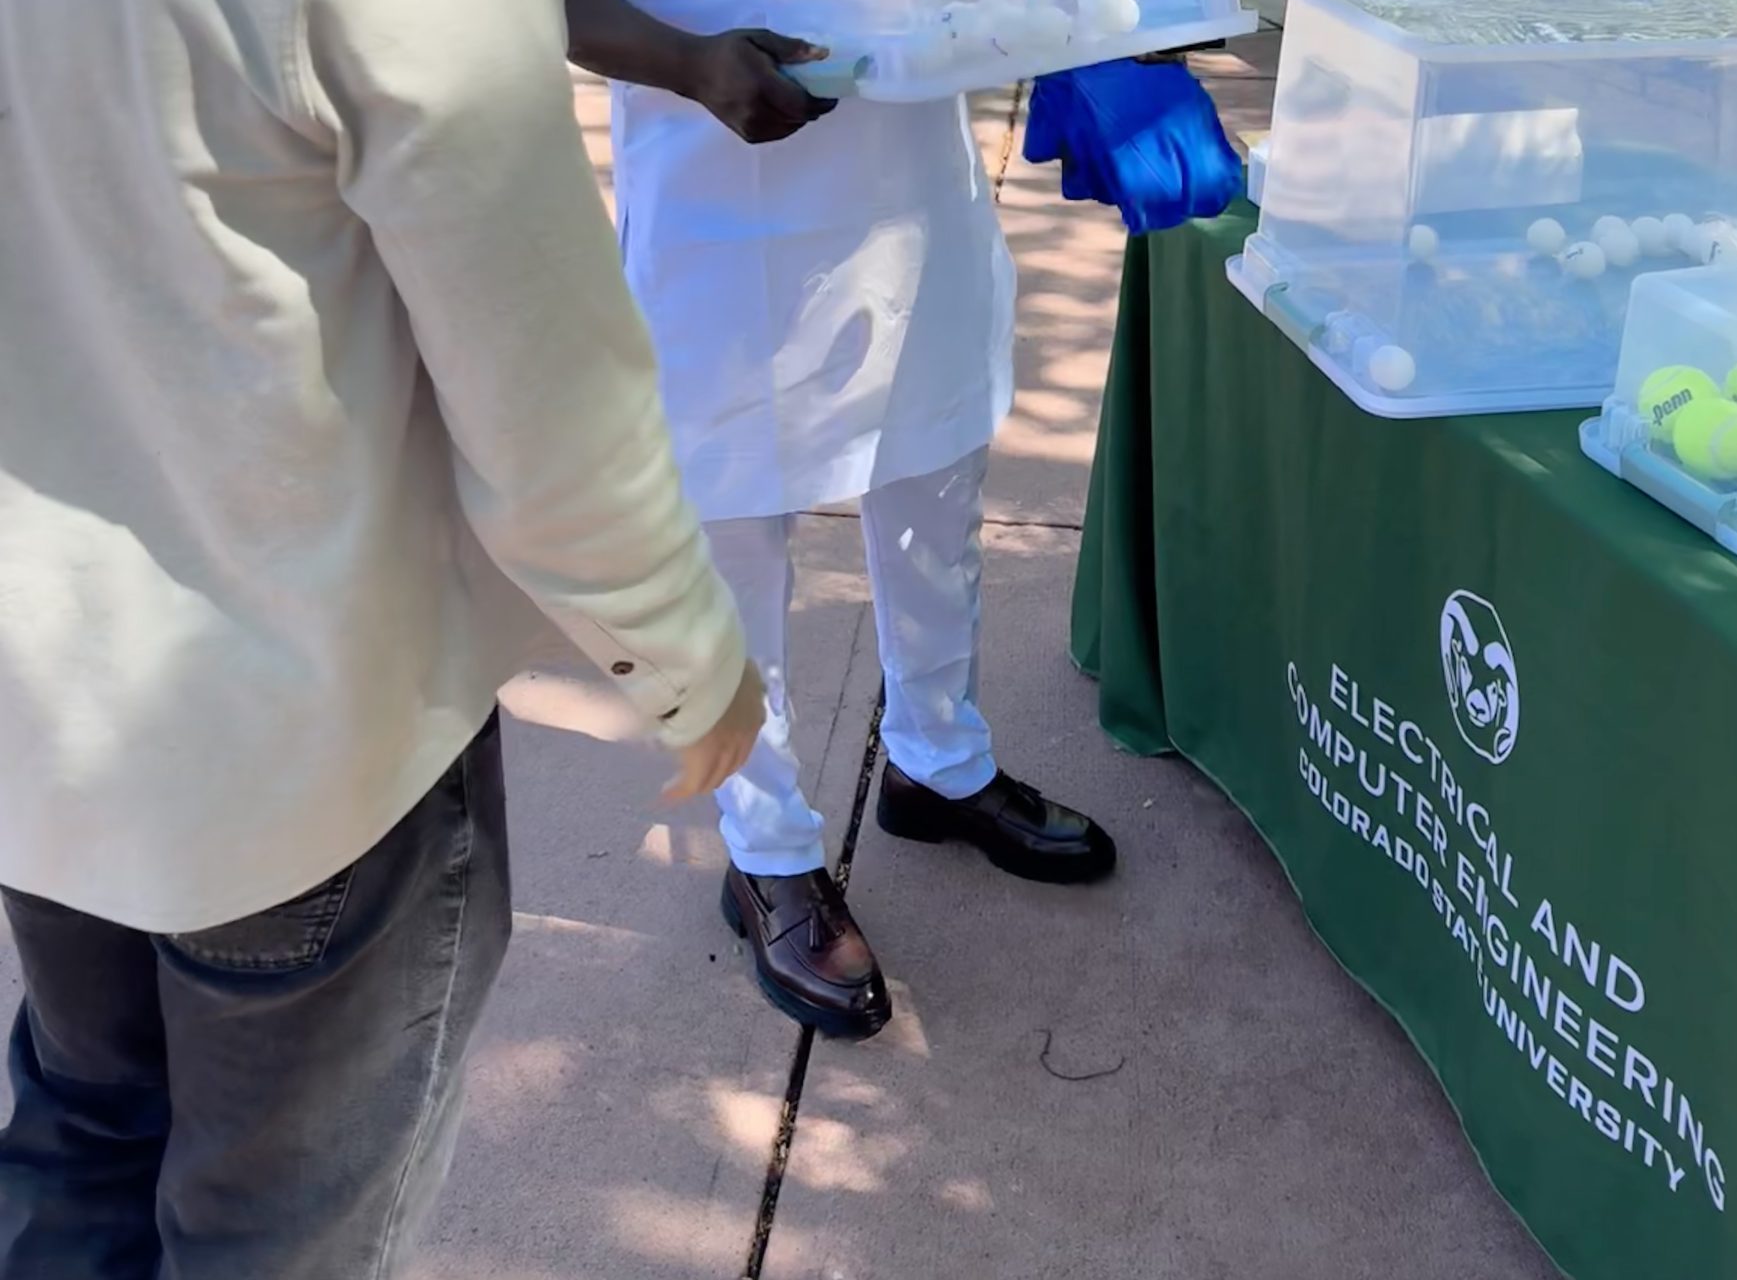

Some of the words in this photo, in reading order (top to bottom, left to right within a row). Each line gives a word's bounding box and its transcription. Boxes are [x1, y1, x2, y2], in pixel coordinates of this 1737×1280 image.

[1287, 661, 1447, 867] COMPUTER
[1457, 852, 1725, 1211] ENGINEERING
[1299, 748, 1429, 889] COLORADO
[1483, 975, 1685, 1192] UNIVERSITY
[1330, 663, 1519, 908] ELECTRICAL
[1530, 898, 1645, 1012] AND
